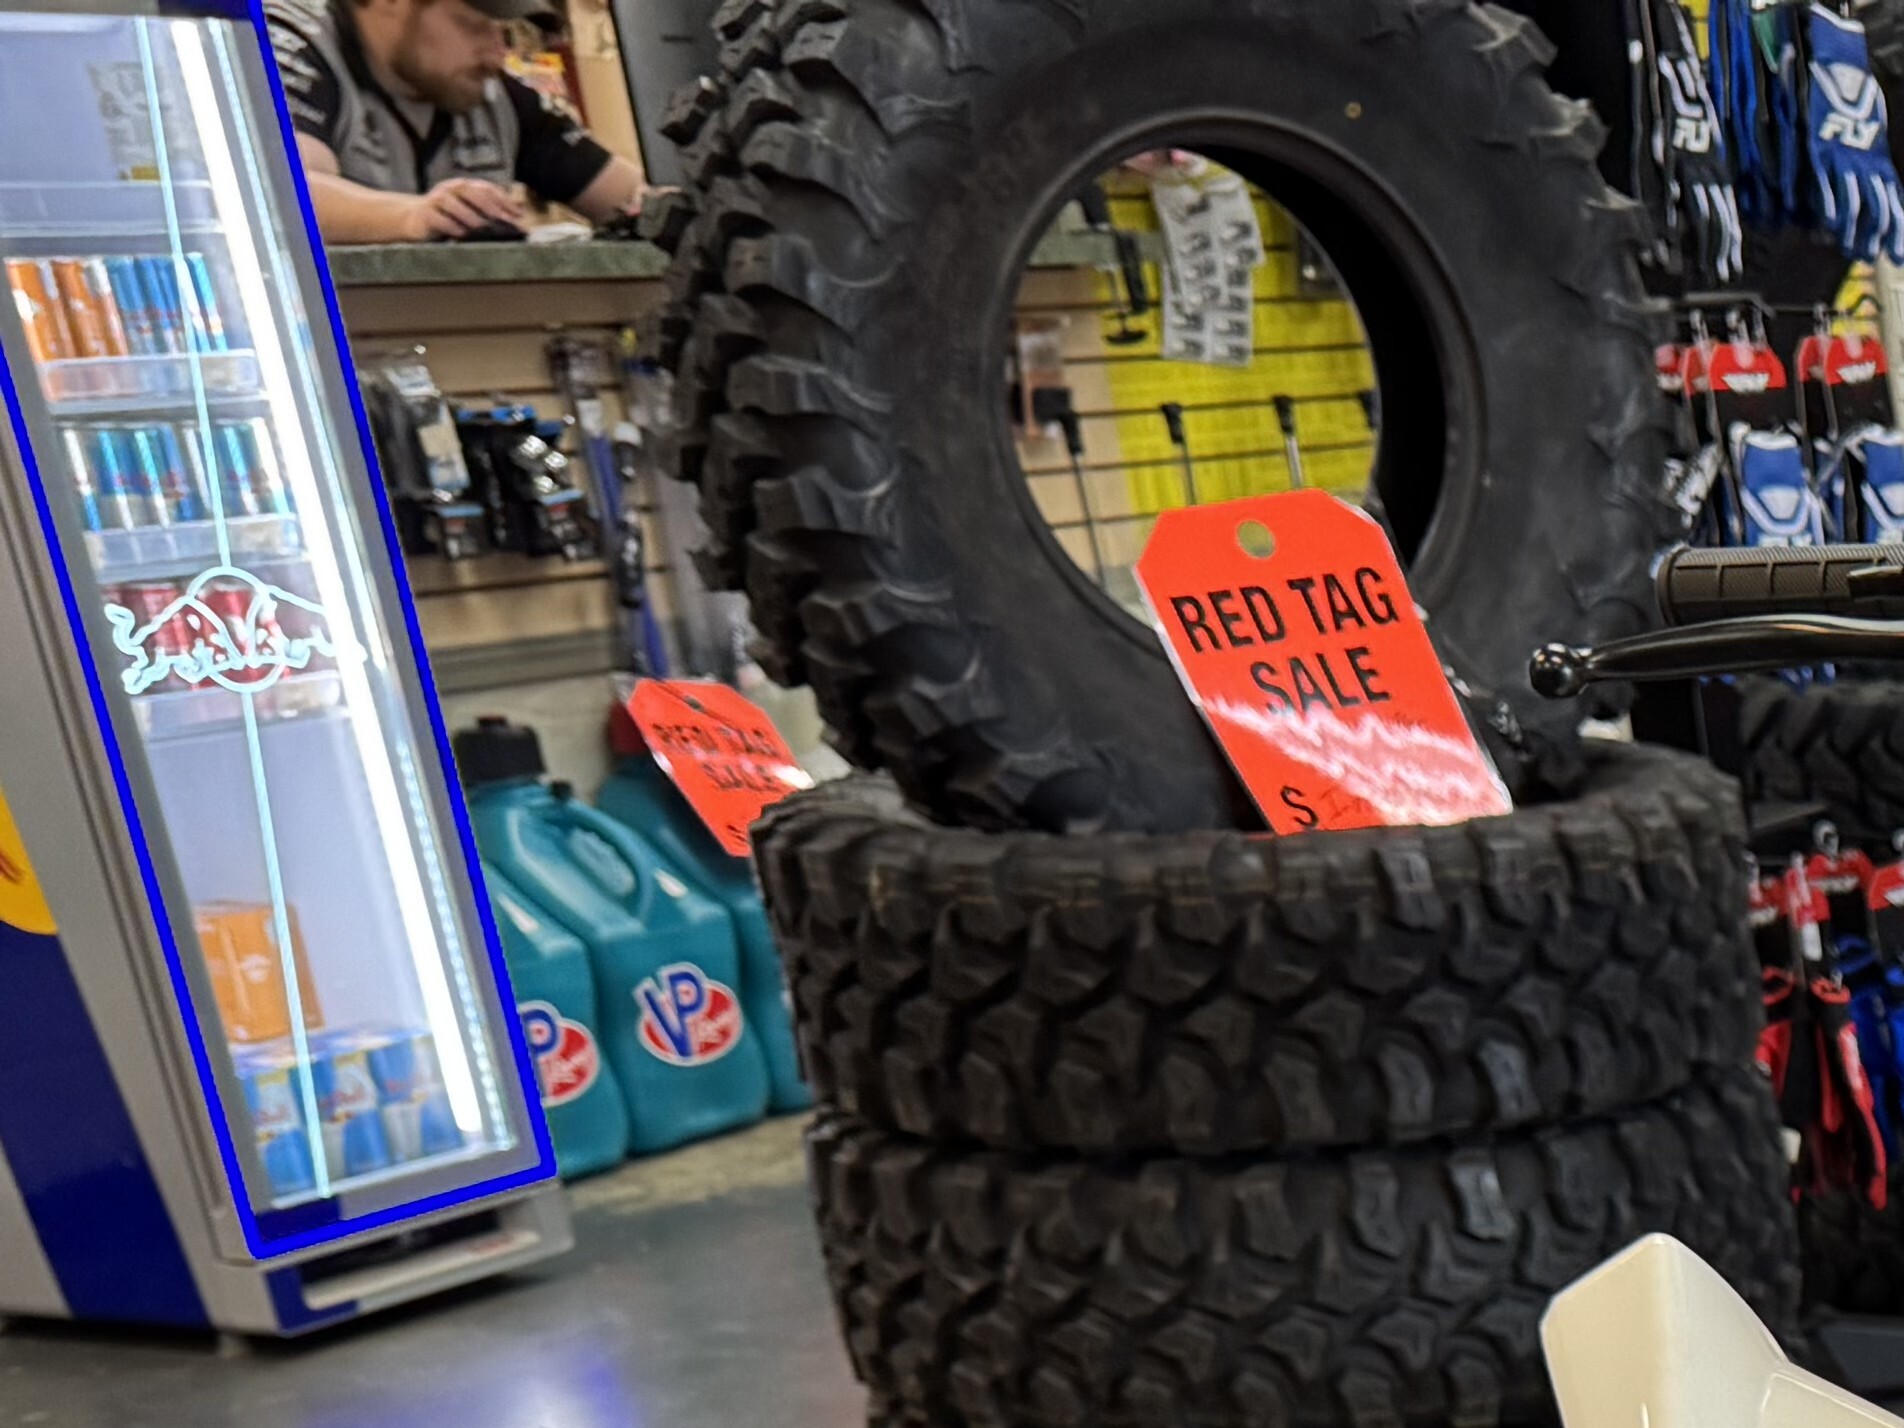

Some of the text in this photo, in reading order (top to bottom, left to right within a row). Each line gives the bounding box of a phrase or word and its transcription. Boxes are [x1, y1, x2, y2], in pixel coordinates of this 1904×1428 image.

[1169, 566, 1400, 653] RED TAG
[1250, 646, 1391, 716] SALE
[642, 971, 705, 1058] VP
